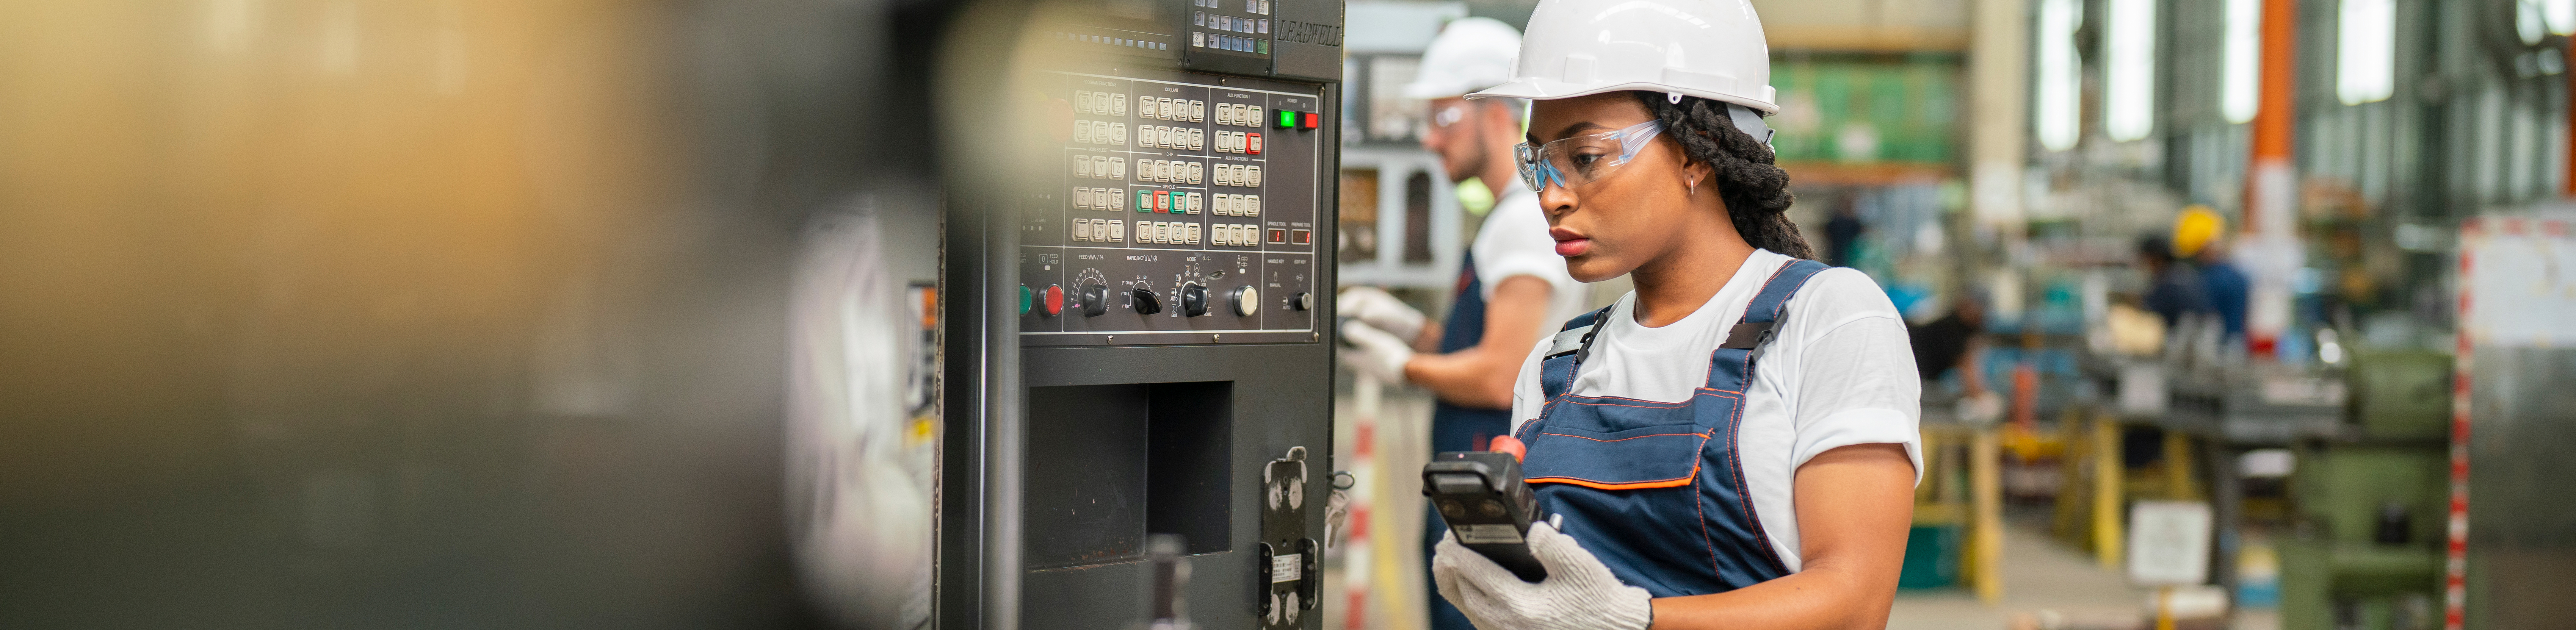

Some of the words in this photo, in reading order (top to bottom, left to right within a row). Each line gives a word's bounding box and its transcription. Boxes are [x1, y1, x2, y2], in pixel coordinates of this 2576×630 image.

[1278, 20, 1340, 47] LEADWELL
[1277, 231, 1280, 242] 1
[1306, 232, 1310, 243] 1
